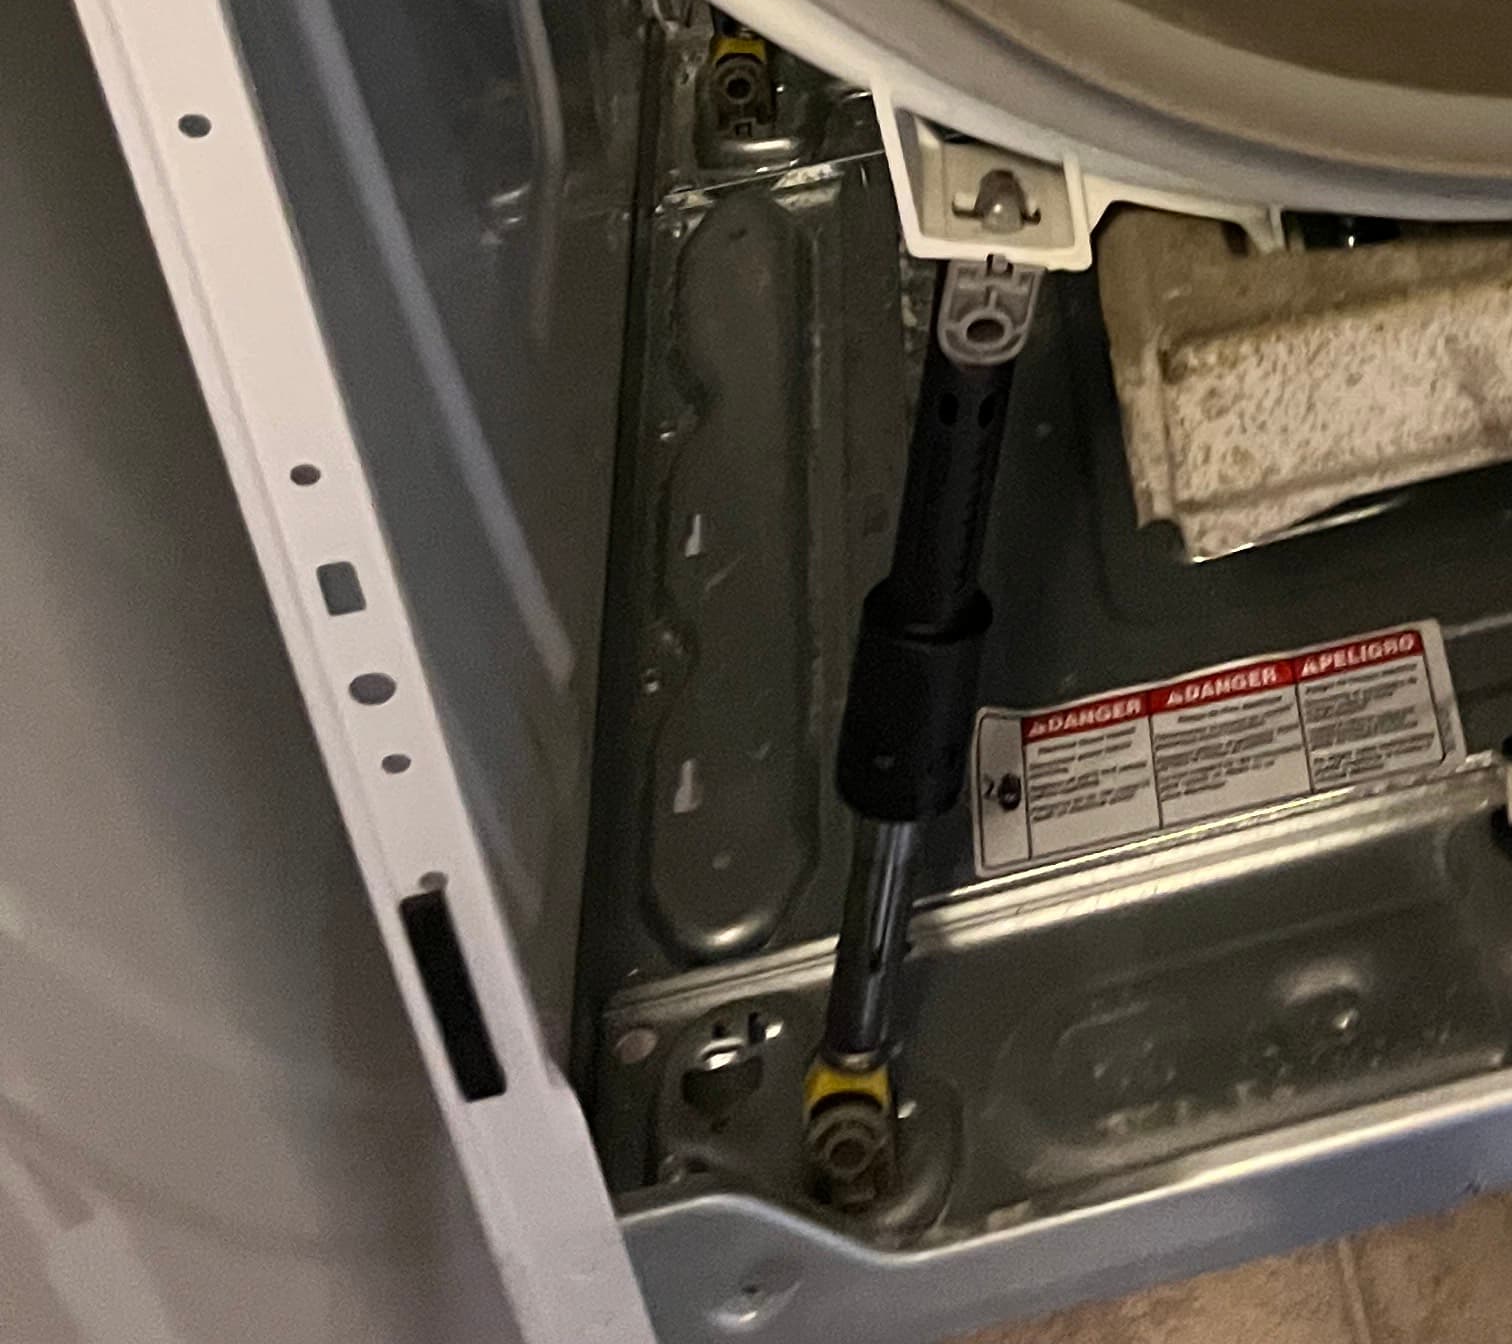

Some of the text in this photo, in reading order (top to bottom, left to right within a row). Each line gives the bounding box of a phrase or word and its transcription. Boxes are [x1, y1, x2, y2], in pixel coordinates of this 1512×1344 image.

[1319, 633, 1415, 672] PELIGRO
[1184, 666, 1277, 701] DANGER
[1048, 698, 1142, 732] DANGER
